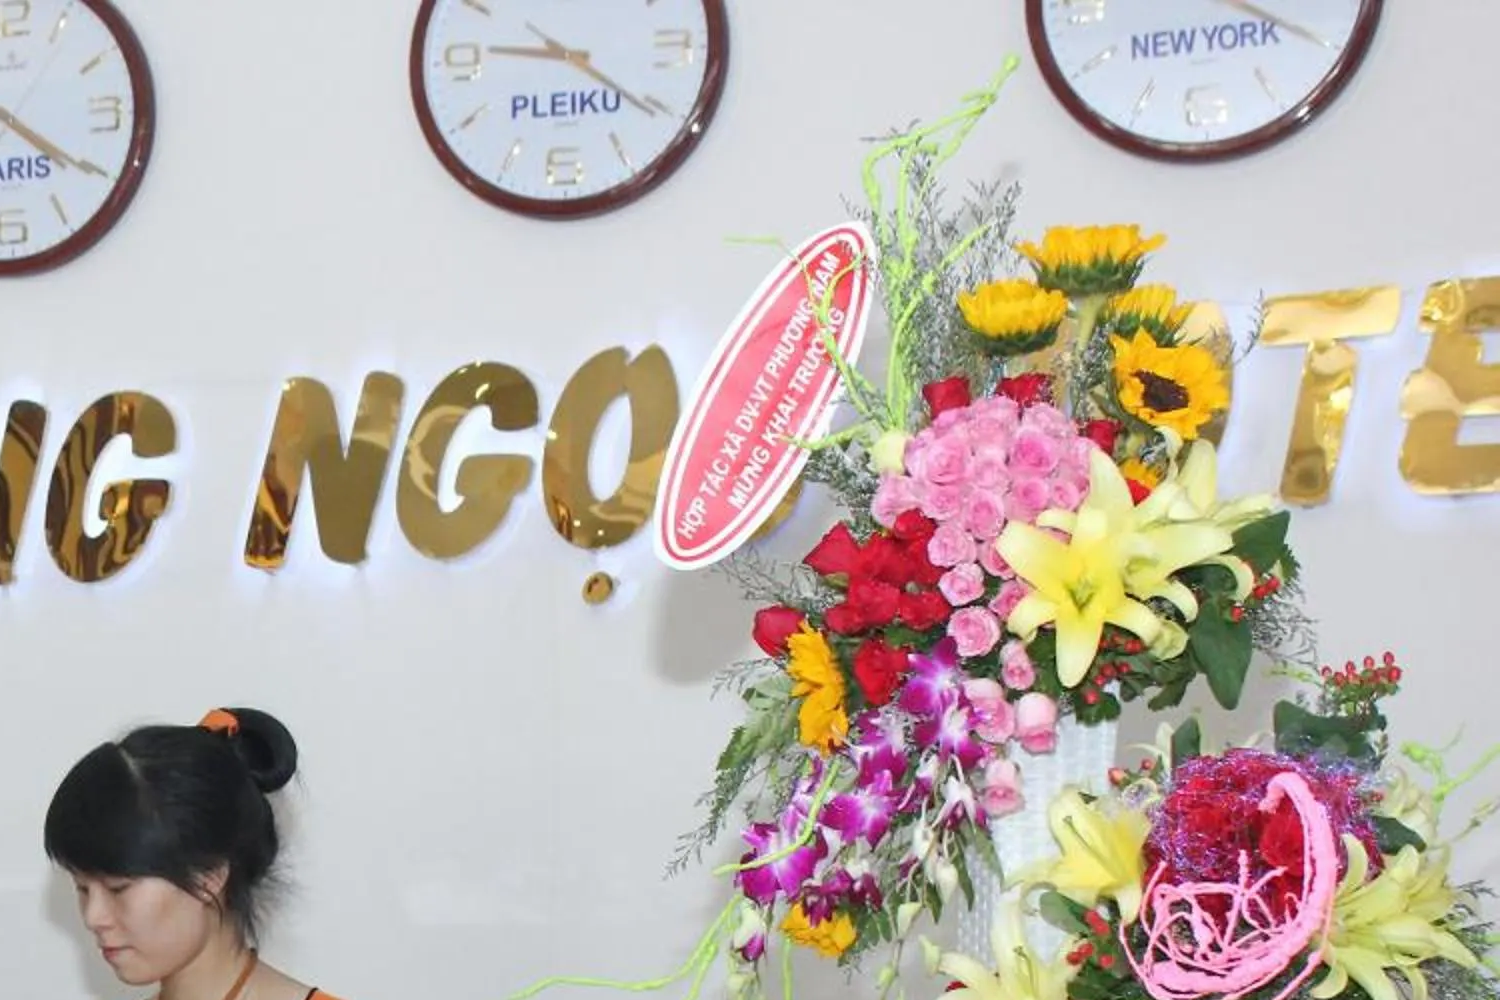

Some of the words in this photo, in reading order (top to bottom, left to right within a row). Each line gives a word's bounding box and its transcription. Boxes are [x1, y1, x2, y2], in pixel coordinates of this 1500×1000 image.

[1131, 27, 1196, 60] NEW
[1201, 20, 1280, 51] YORK
[511, 90, 622, 119] PLEIKU
[811, 252, 841, 299] NAM
[761, 394, 798, 447] KHAI
[242, 343, 803, 605] NGỌ
